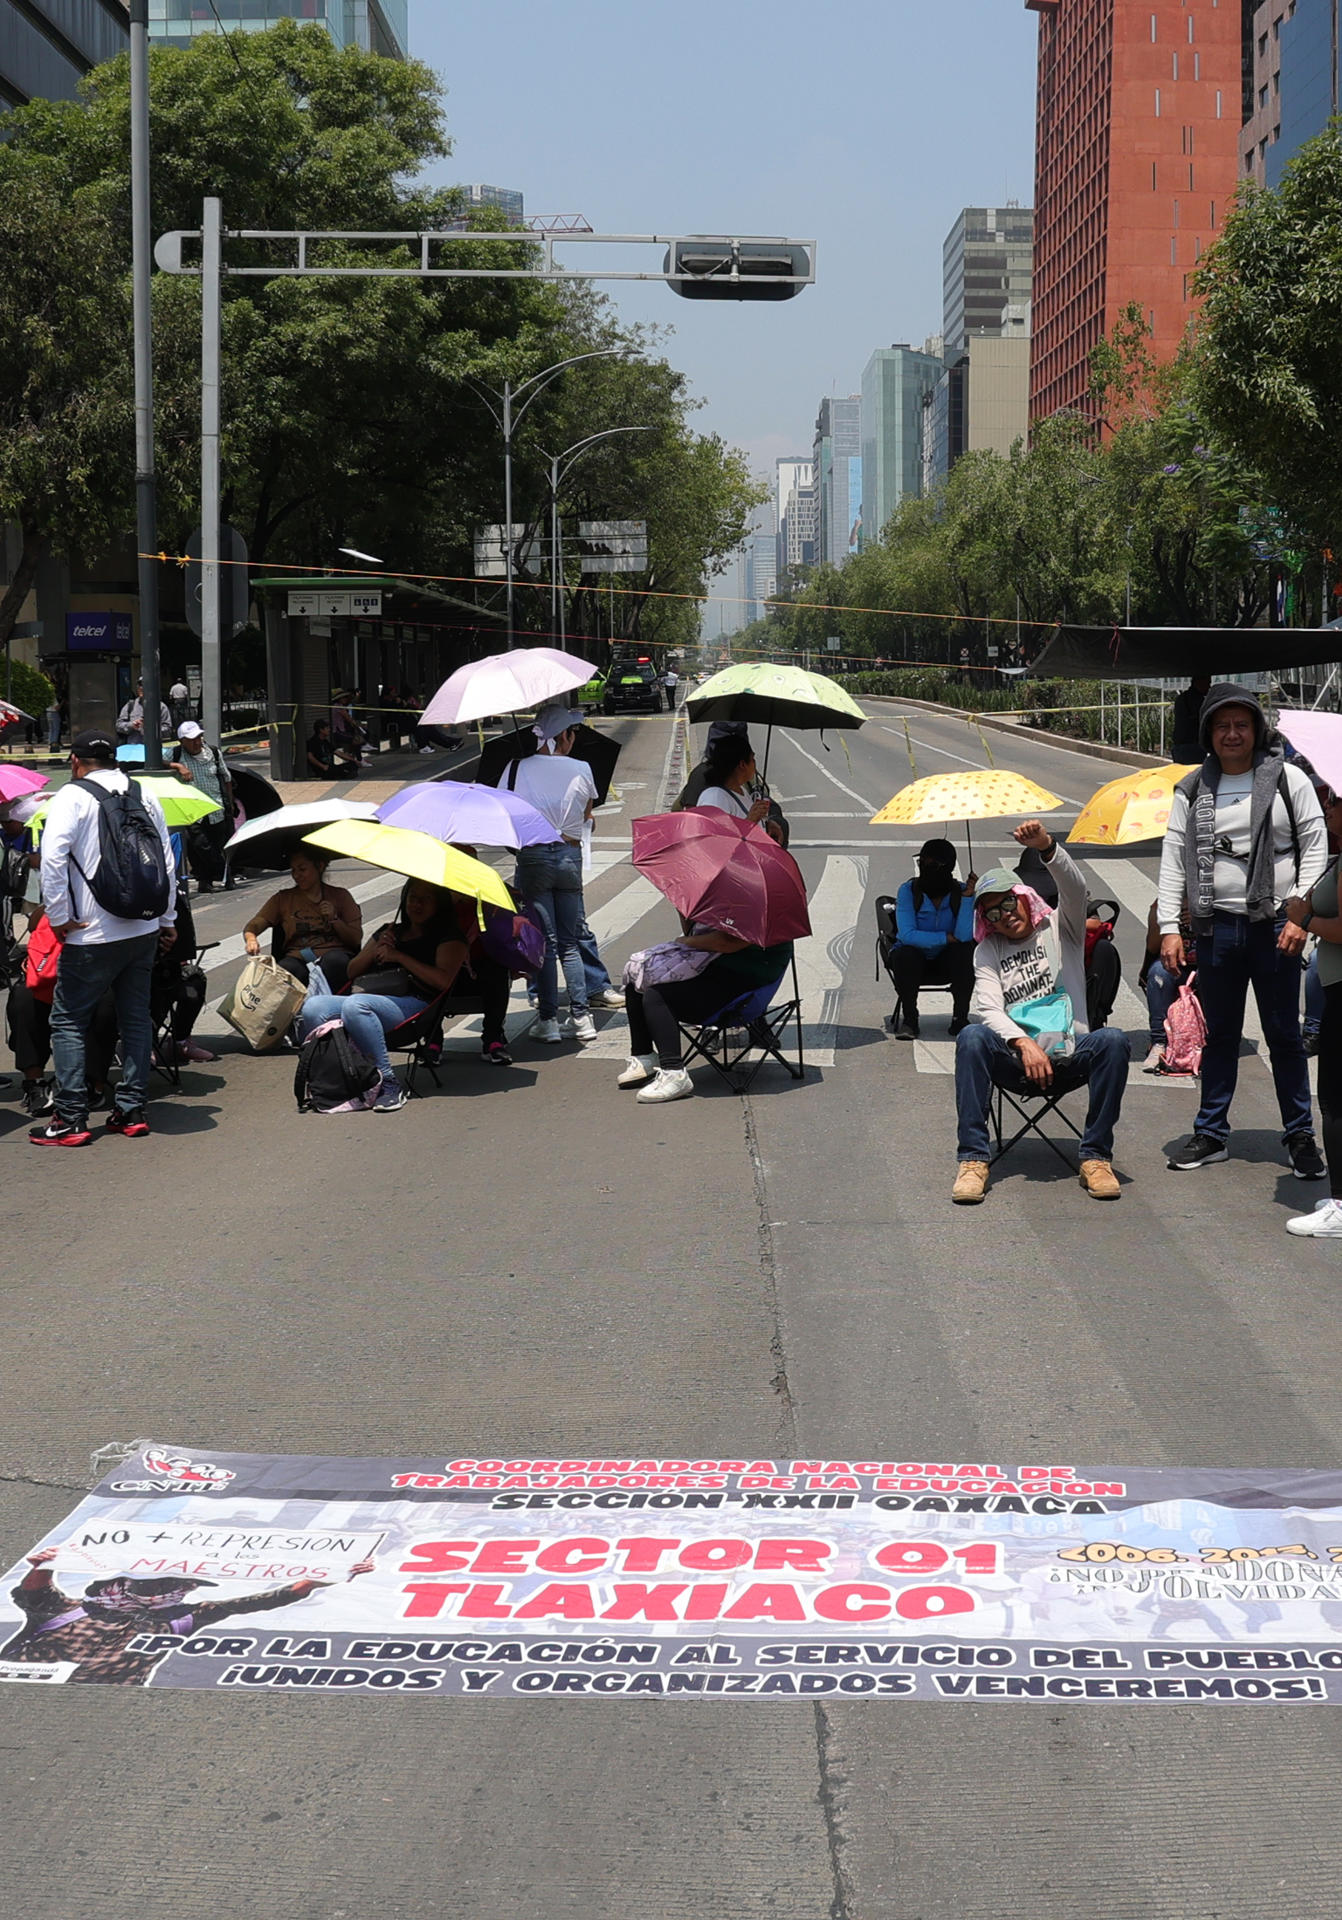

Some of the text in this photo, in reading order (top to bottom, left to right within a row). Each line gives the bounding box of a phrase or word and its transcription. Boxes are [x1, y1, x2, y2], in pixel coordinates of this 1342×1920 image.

[73, 625, 107, 637] telcel
[1019, 962, 1041, 981] THE
[1003, 972, 1054, 1004] DOMINAT
[448, 1460, 1074, 1480] COORDINADORA NACIONAL DE
[393, 1474, 1124, 1496] TRABAJADORES DE LA EDUCACIÓN
[491, 1489, 1107, 1516] SECCIÓN XXII OAXACA
[82, 1530, 355, 1552] NO + REPRESION
[399, 1537, 997, 1574] SECTOR 01
[129, 1558, 330, 1578] MAESTROS
[401, 1582, 975, 1622] TLAXIACO
[127, 1635, 253, 1656] ¡POR
[264, 1638, 329, 1658] LA
[345, 1638, 658, 1663] EDUCACIÓN
[672, 1645, 739, 1665] AL
[757, 1645, 1013, 1666] SERVICIO
[1032, 1648, 1129, 1668] DEL
[220, 1665, 1325, 1699] ¡UNIDOS Y ORGANIZADOS VENCEREMOS!
